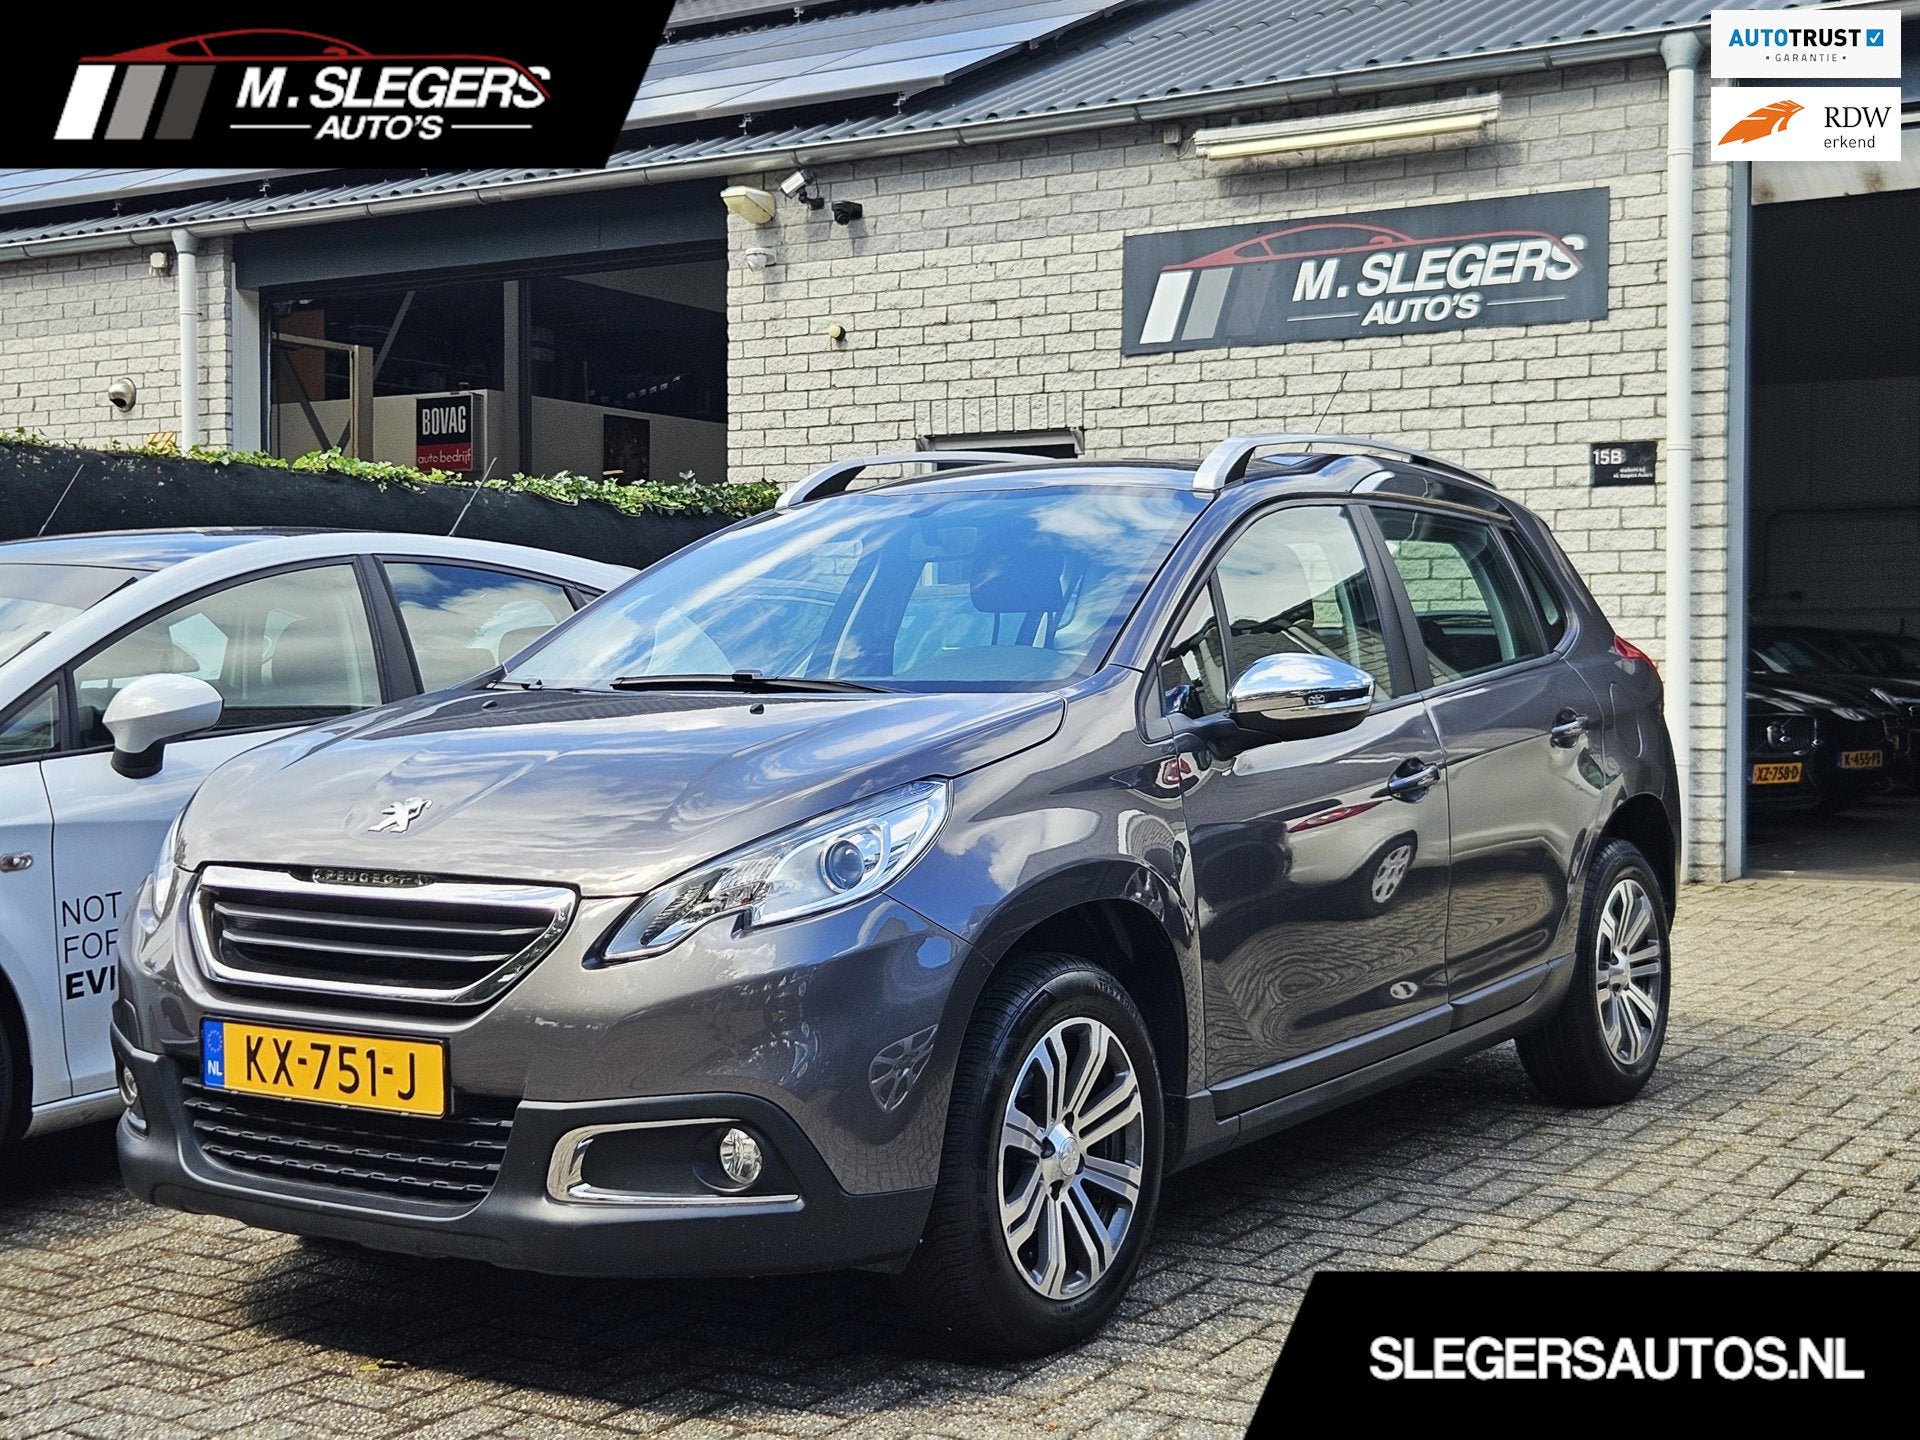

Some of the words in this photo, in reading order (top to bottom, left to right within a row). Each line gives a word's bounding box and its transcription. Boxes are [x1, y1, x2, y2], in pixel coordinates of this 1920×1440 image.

[1292, 258, 1350, 301] M.
[1356, 233, 1588, 297] SLEGERS
[1361, 292, 1483, 326] AUTO'S
[422, 406, 466, 435] BOVAG
[1592, 449, 1624, 465] 15B
[1756, 765, 1799, 782] XZ-758-D
[61, 891, 123, 927] NOT
[207, 1060, 223, 1076] NL
[246, 1034, 416, 1101] KX-751-J
